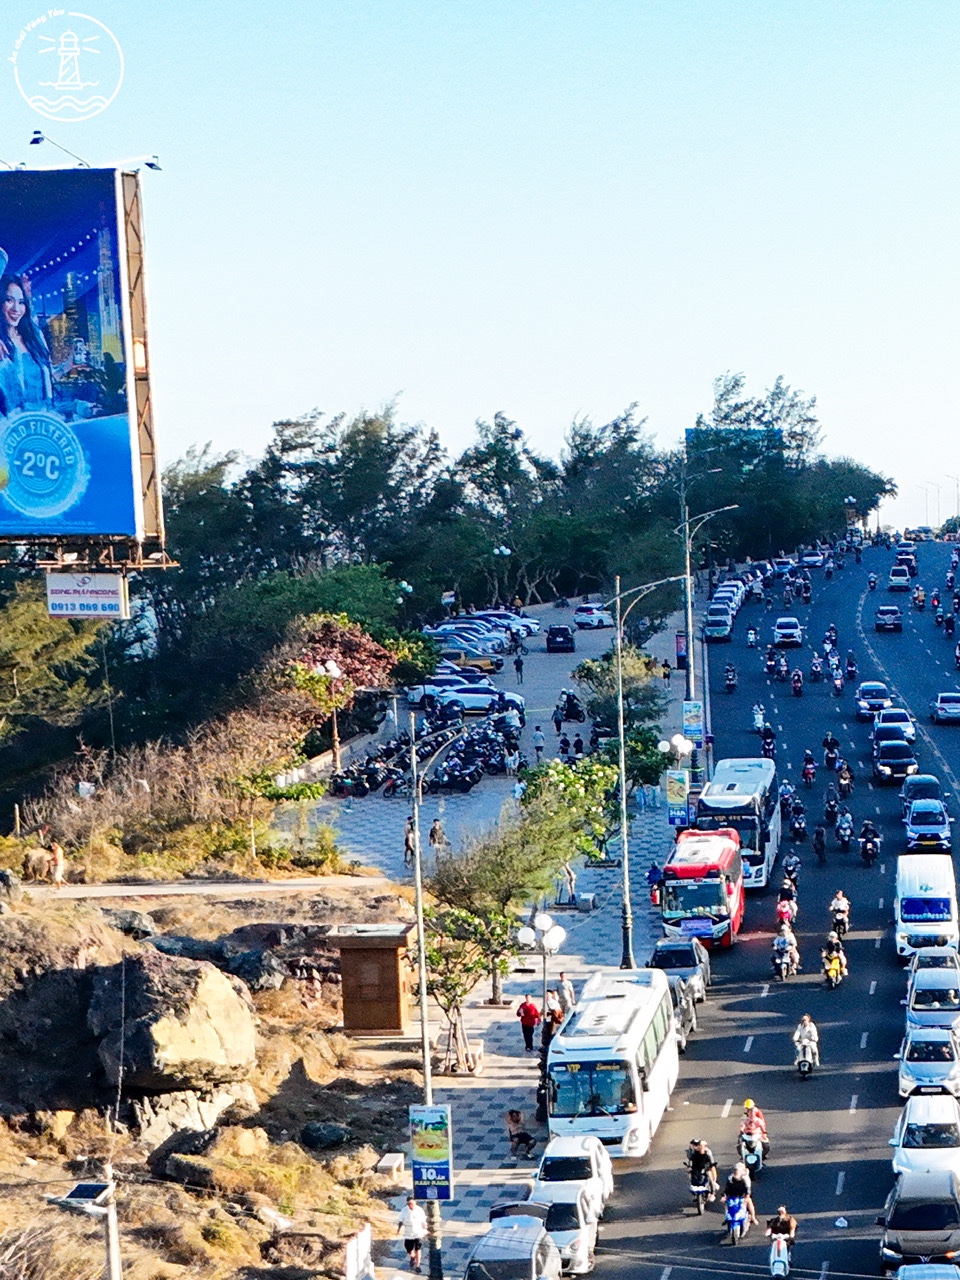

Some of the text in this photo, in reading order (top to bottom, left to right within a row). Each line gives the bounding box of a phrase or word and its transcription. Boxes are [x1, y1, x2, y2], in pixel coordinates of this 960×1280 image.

[5, 421, 75, 465] COLD FILTERED
[51, 603, 77, 611] 0913
[421, 1168, 437, 1180] 10
